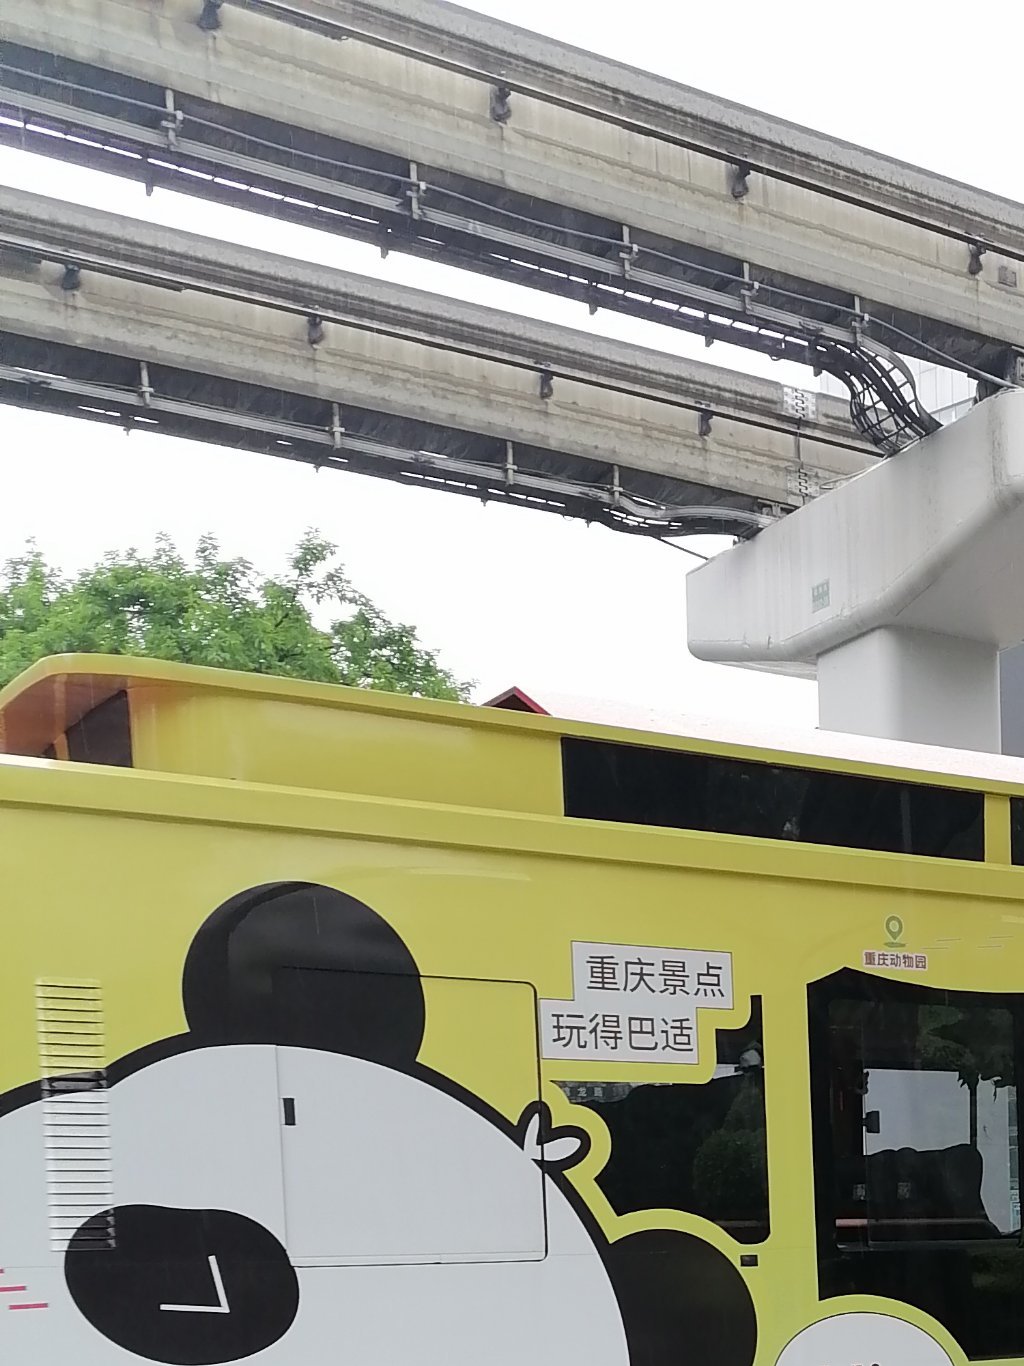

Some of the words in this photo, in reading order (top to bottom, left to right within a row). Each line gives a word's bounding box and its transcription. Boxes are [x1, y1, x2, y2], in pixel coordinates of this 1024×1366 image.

[586, 955, 725, 998] 重庆景点
[863, 951, 927, 969] 重庆动物园
[551, 1013, 694, 1052] 玩得巴适
